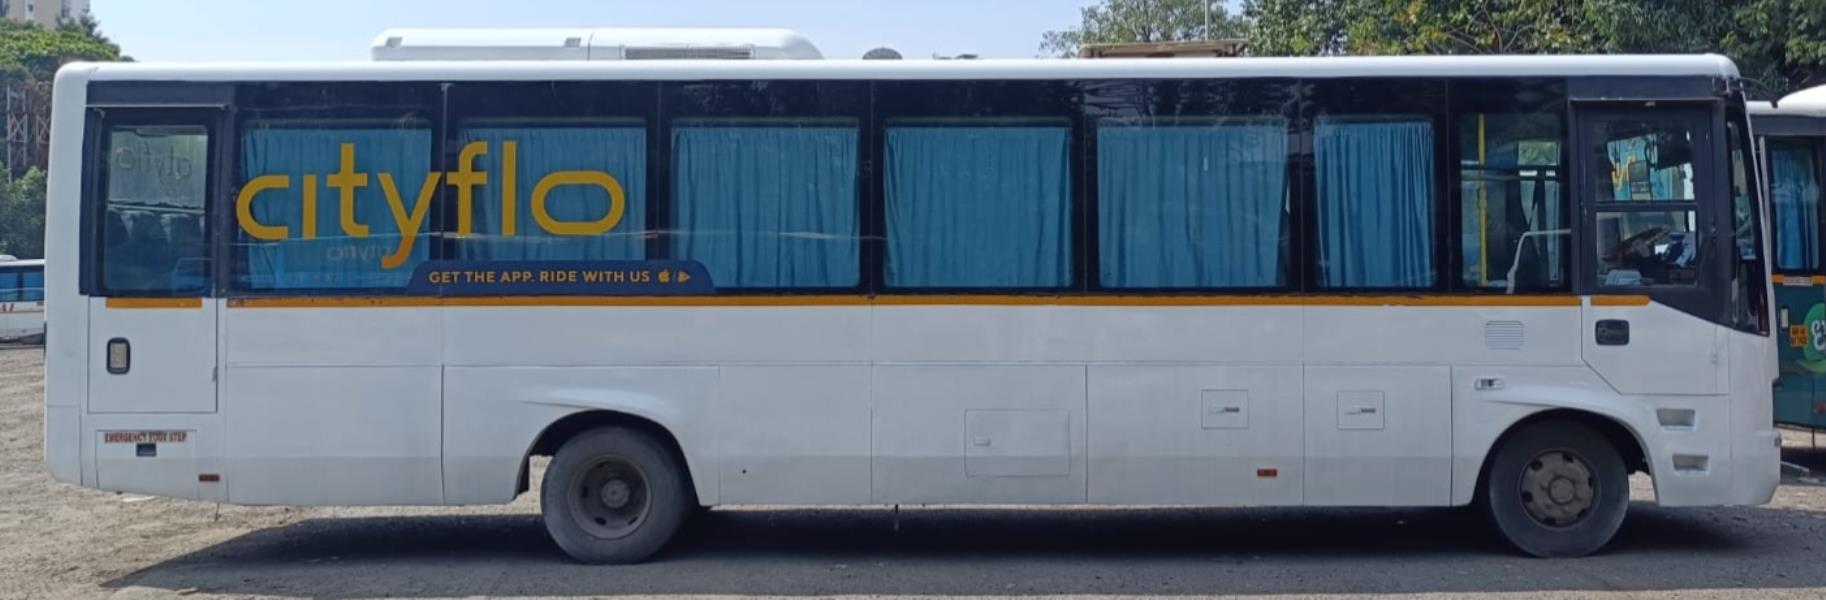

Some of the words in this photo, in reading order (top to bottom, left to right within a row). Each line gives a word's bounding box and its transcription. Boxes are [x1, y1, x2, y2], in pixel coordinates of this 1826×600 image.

[236, 141, 625, 268] cityflo
[428, 271, 460, 284] GET
[464, 271, 495, 283] THE
[500, 271, 534, 283] APP.
[539, 271, 577, 282] RIDE
[582, 271, 624, 283] WITH
[629, 271, 650, 283] US
